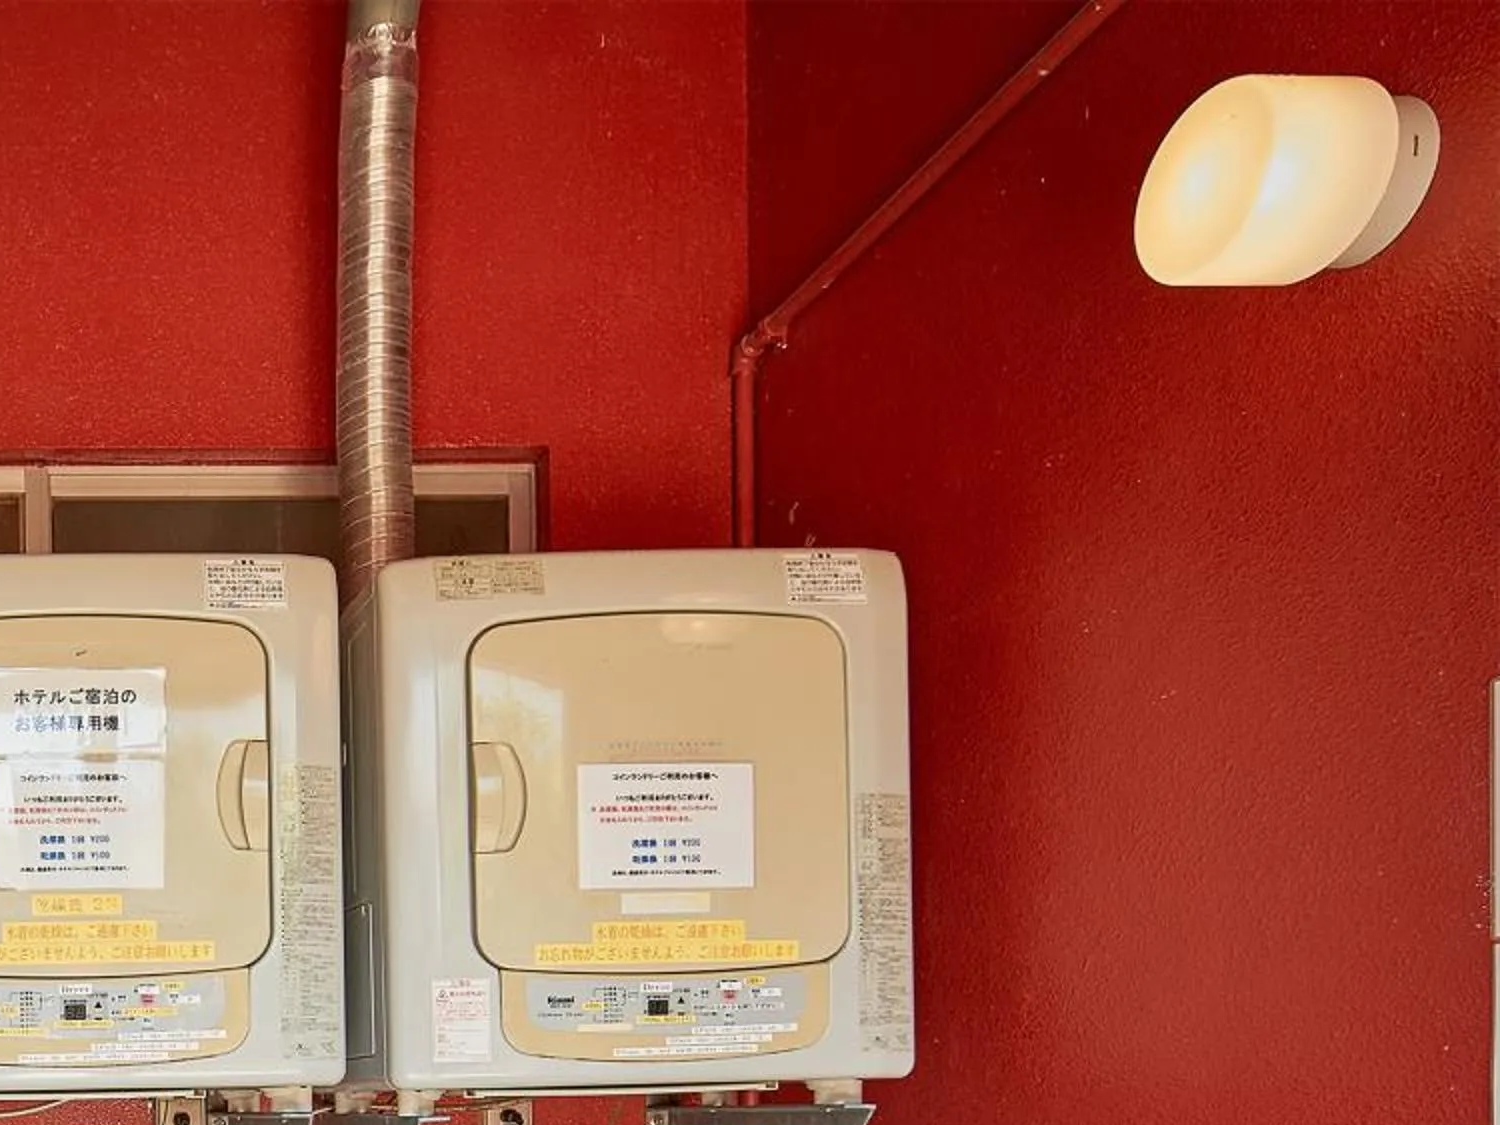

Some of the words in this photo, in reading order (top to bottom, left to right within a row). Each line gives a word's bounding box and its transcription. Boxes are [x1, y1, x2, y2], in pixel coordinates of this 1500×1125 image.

[13, 688, 137, 706] ホテルご宿泊の
[14, 715, 120, 733] お客様専用機
